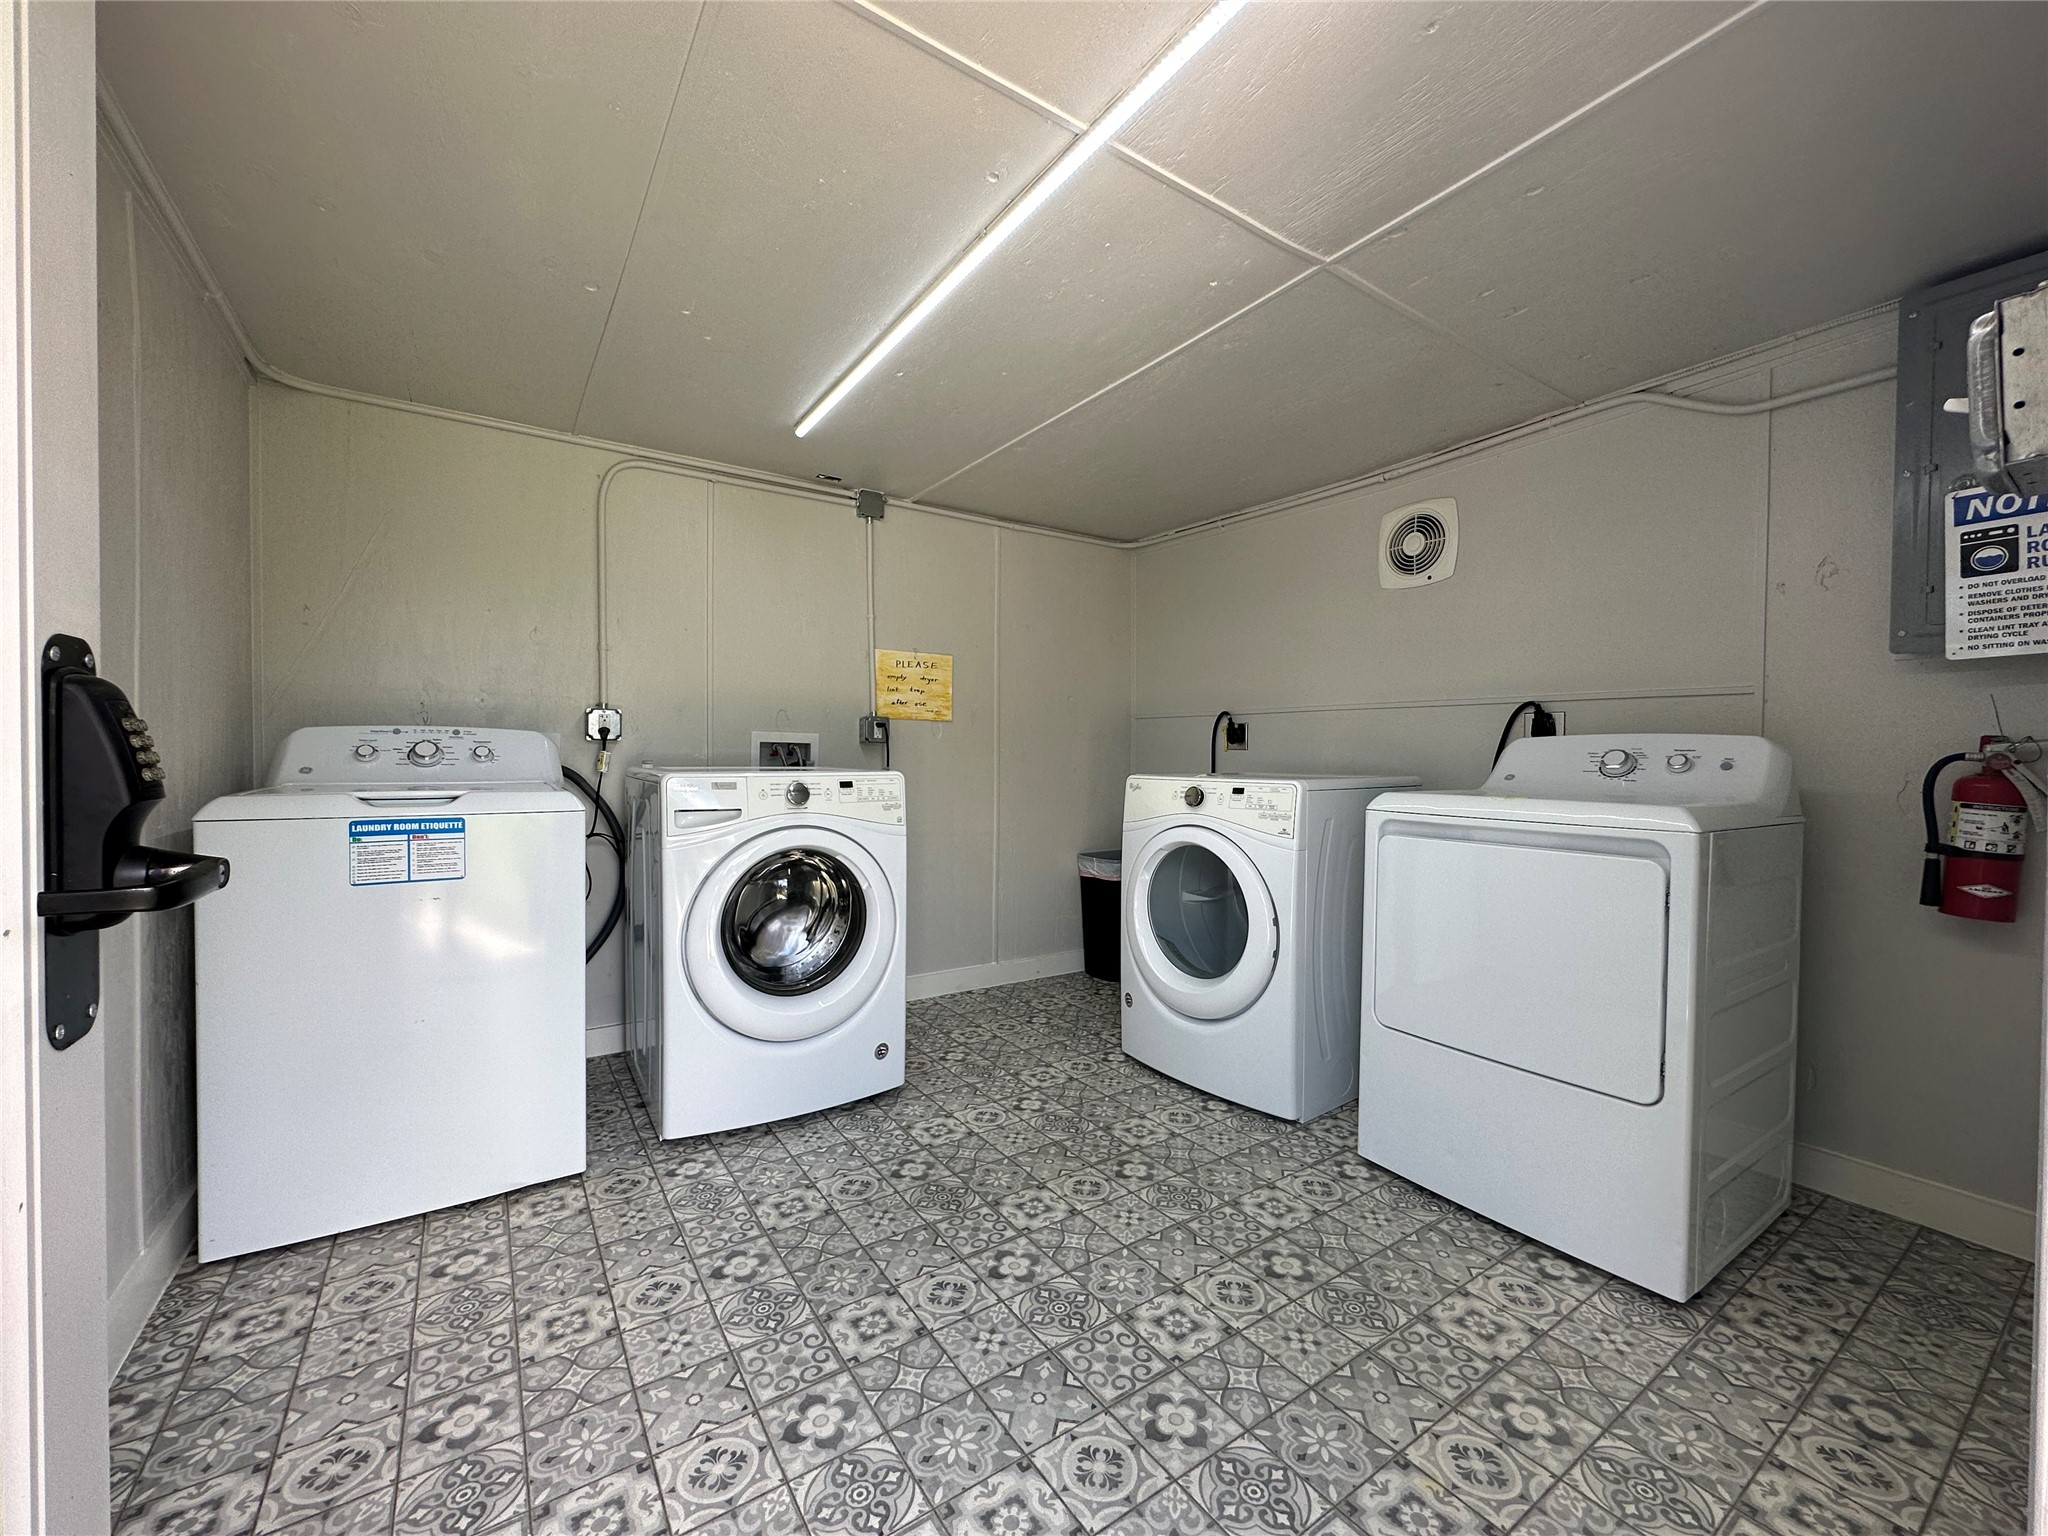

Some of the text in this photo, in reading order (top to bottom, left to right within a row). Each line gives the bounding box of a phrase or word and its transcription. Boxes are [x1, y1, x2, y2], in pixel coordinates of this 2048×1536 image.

[1965, 493, 2048, 520] NOT
[2001, 575, 2046, 585] OVERLOAD
[1968, 590, 2003, 599] REMOVE
[2005, 586, 2043, 595] CLOTHES
[1968, 597, 2008, 606] WASHERS
[1968, 608, 2004, 616] DISPOSE
[2020, 603, 2048, 611] DETER
[1968, 614, 2020, 624] CONTAINERS
[1968, 630, 2029, 641] DRYING CYCLE
[896, 660, 938, 669] PLEASE
[887, 674, 939, 685] empty dryer
[910, 686, 925, 694] trap
[352, 821, 463, 832] LAUNDRY ROOM ETIQUETTE
